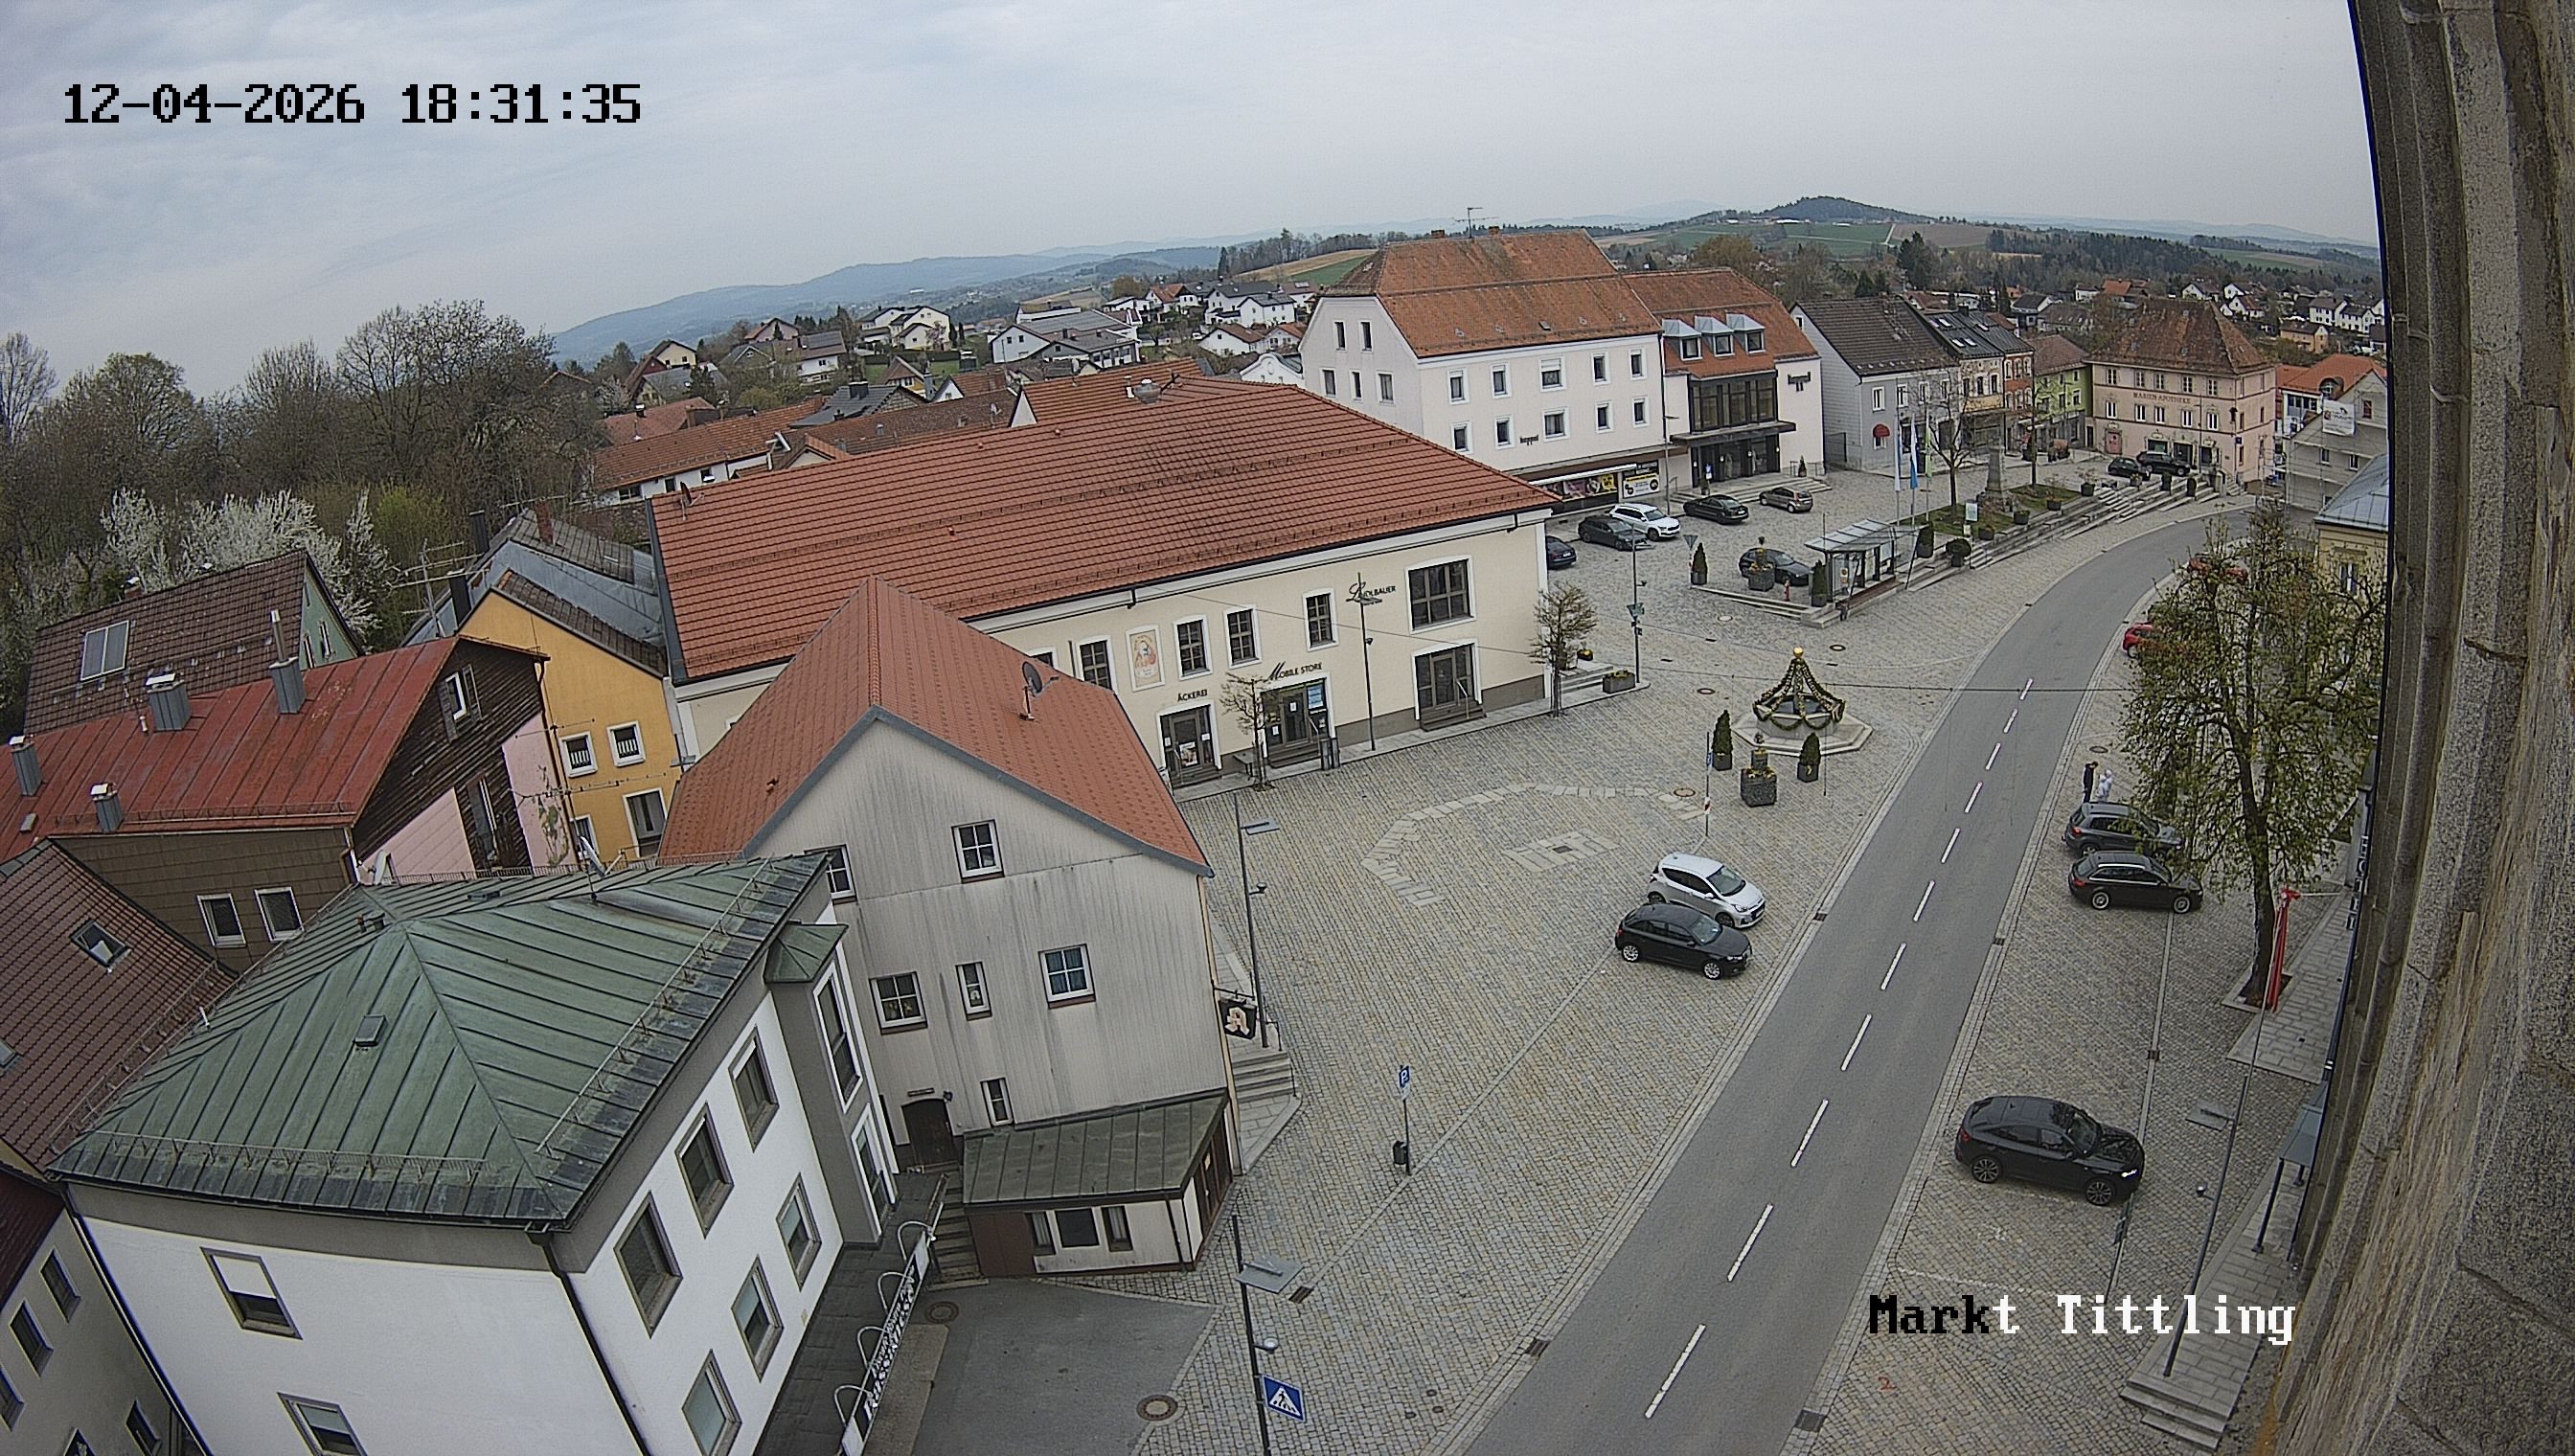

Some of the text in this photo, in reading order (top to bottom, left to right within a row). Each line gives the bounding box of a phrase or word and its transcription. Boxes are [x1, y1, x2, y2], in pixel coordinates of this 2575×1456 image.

[2157, 394, 2191, 404] APOTHEKE
[1300, 661, 1323, 674] STORE
[1401, 1069, 1408, 1084] P
